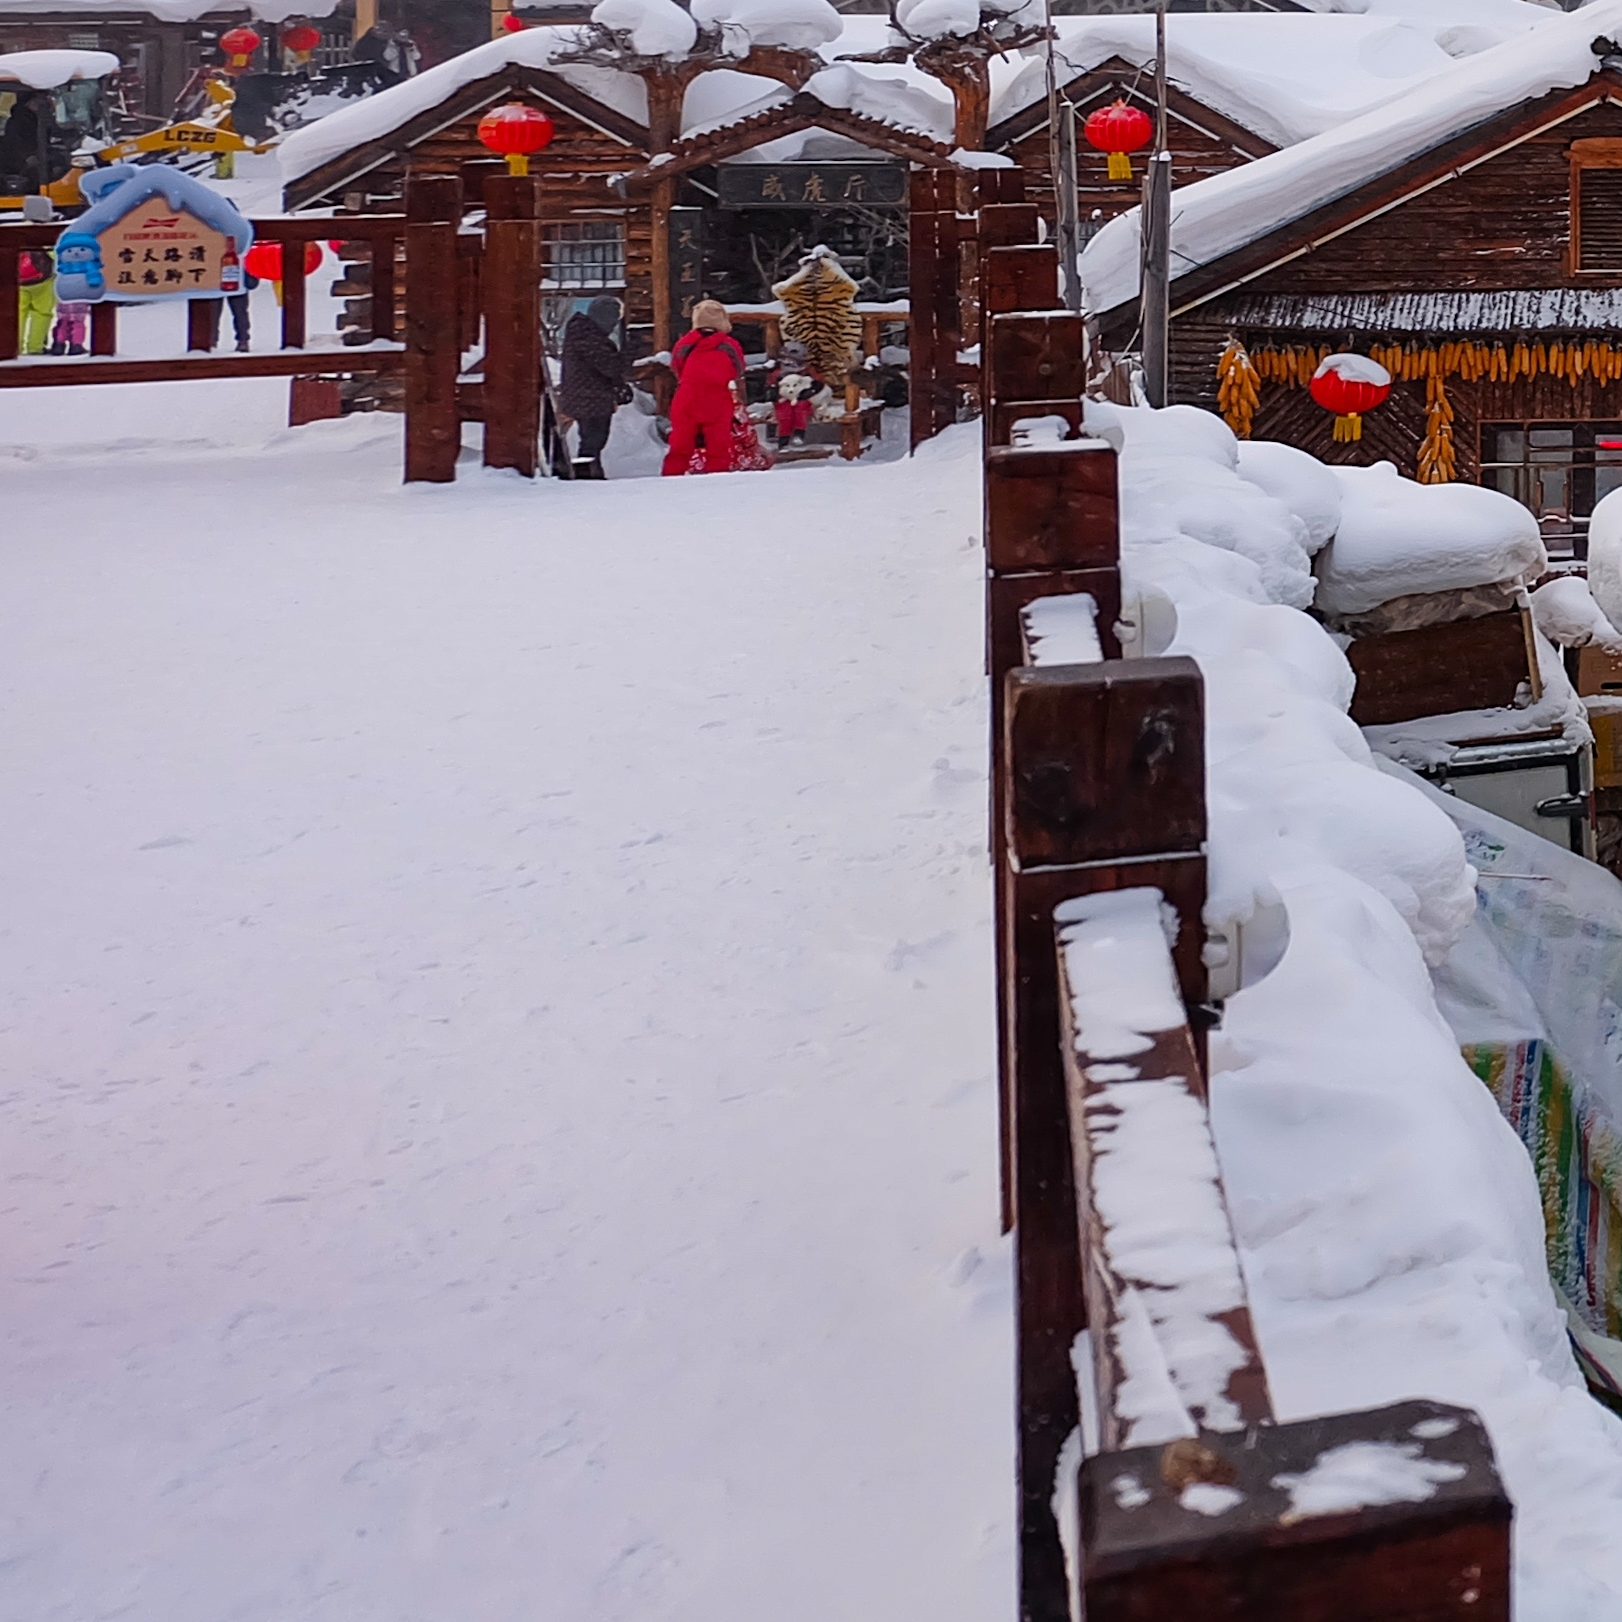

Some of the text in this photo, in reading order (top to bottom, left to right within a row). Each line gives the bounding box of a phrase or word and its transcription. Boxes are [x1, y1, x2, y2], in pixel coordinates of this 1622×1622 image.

[163, 129, 217, 144] LCZG
[118, 245, 207, 264] 雪天路滑
[117, 268, 207, 285] 注意脚下
